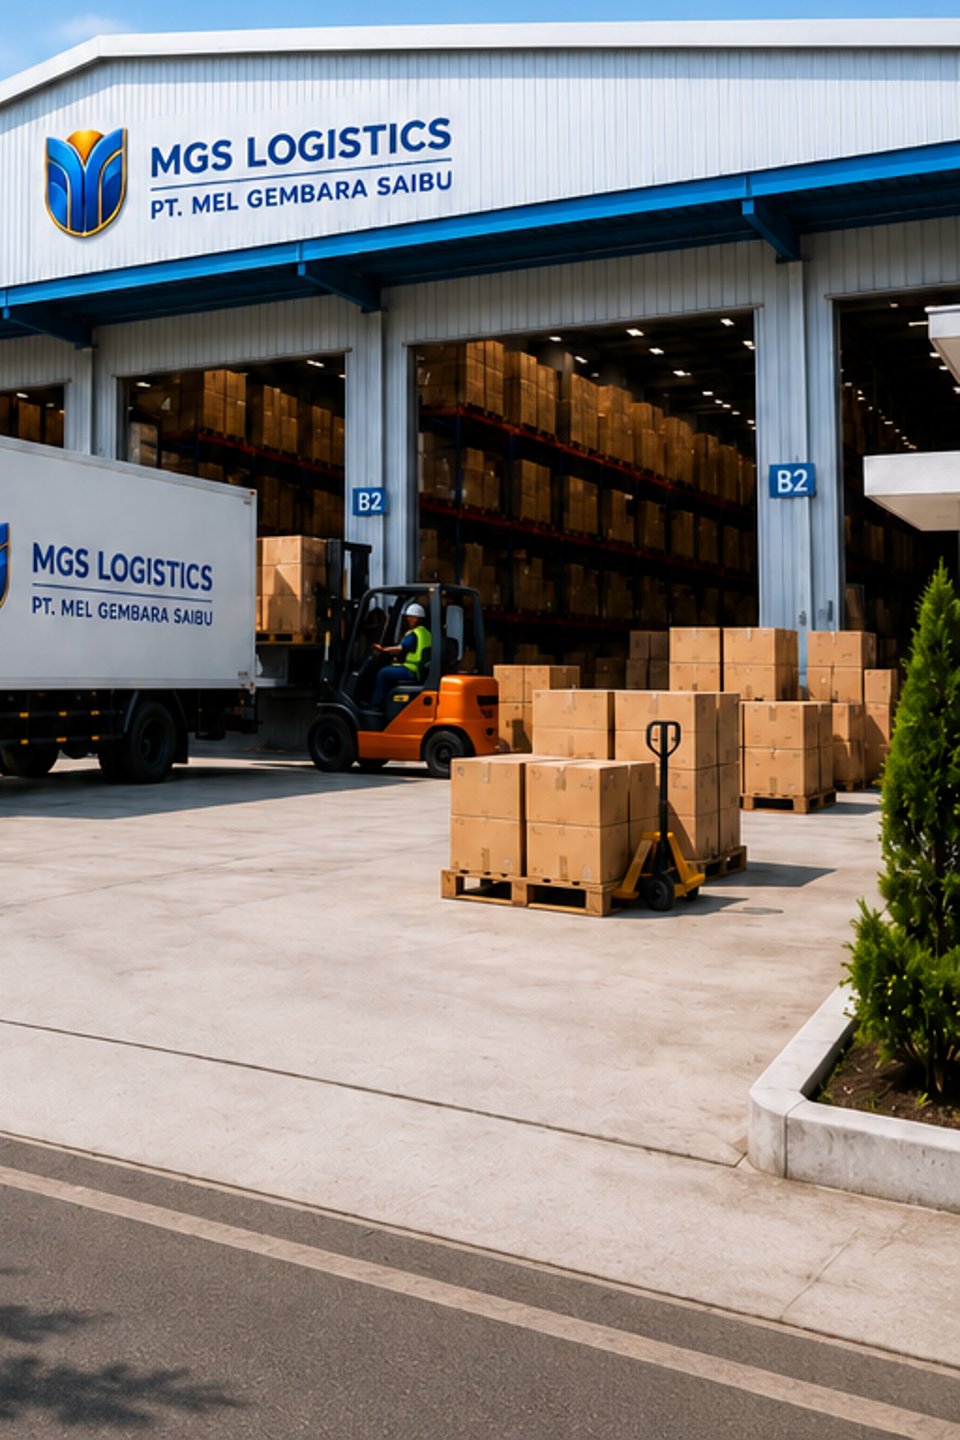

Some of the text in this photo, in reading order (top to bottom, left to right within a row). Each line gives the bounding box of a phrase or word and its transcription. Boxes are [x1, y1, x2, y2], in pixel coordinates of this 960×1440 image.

[151, 117, 452, 178] MGS LOGISTICS
[151, 170, 452, 220] PT. MEL GEMBARA SAIBU
[777, 468, 808, 493] B2
[358, 491, 382, 511] B2
[32, 542, 213, 592] MGS LOGISTICS
[32, 596, 213, 627] PT. MEL GEMBARA SAIBU
